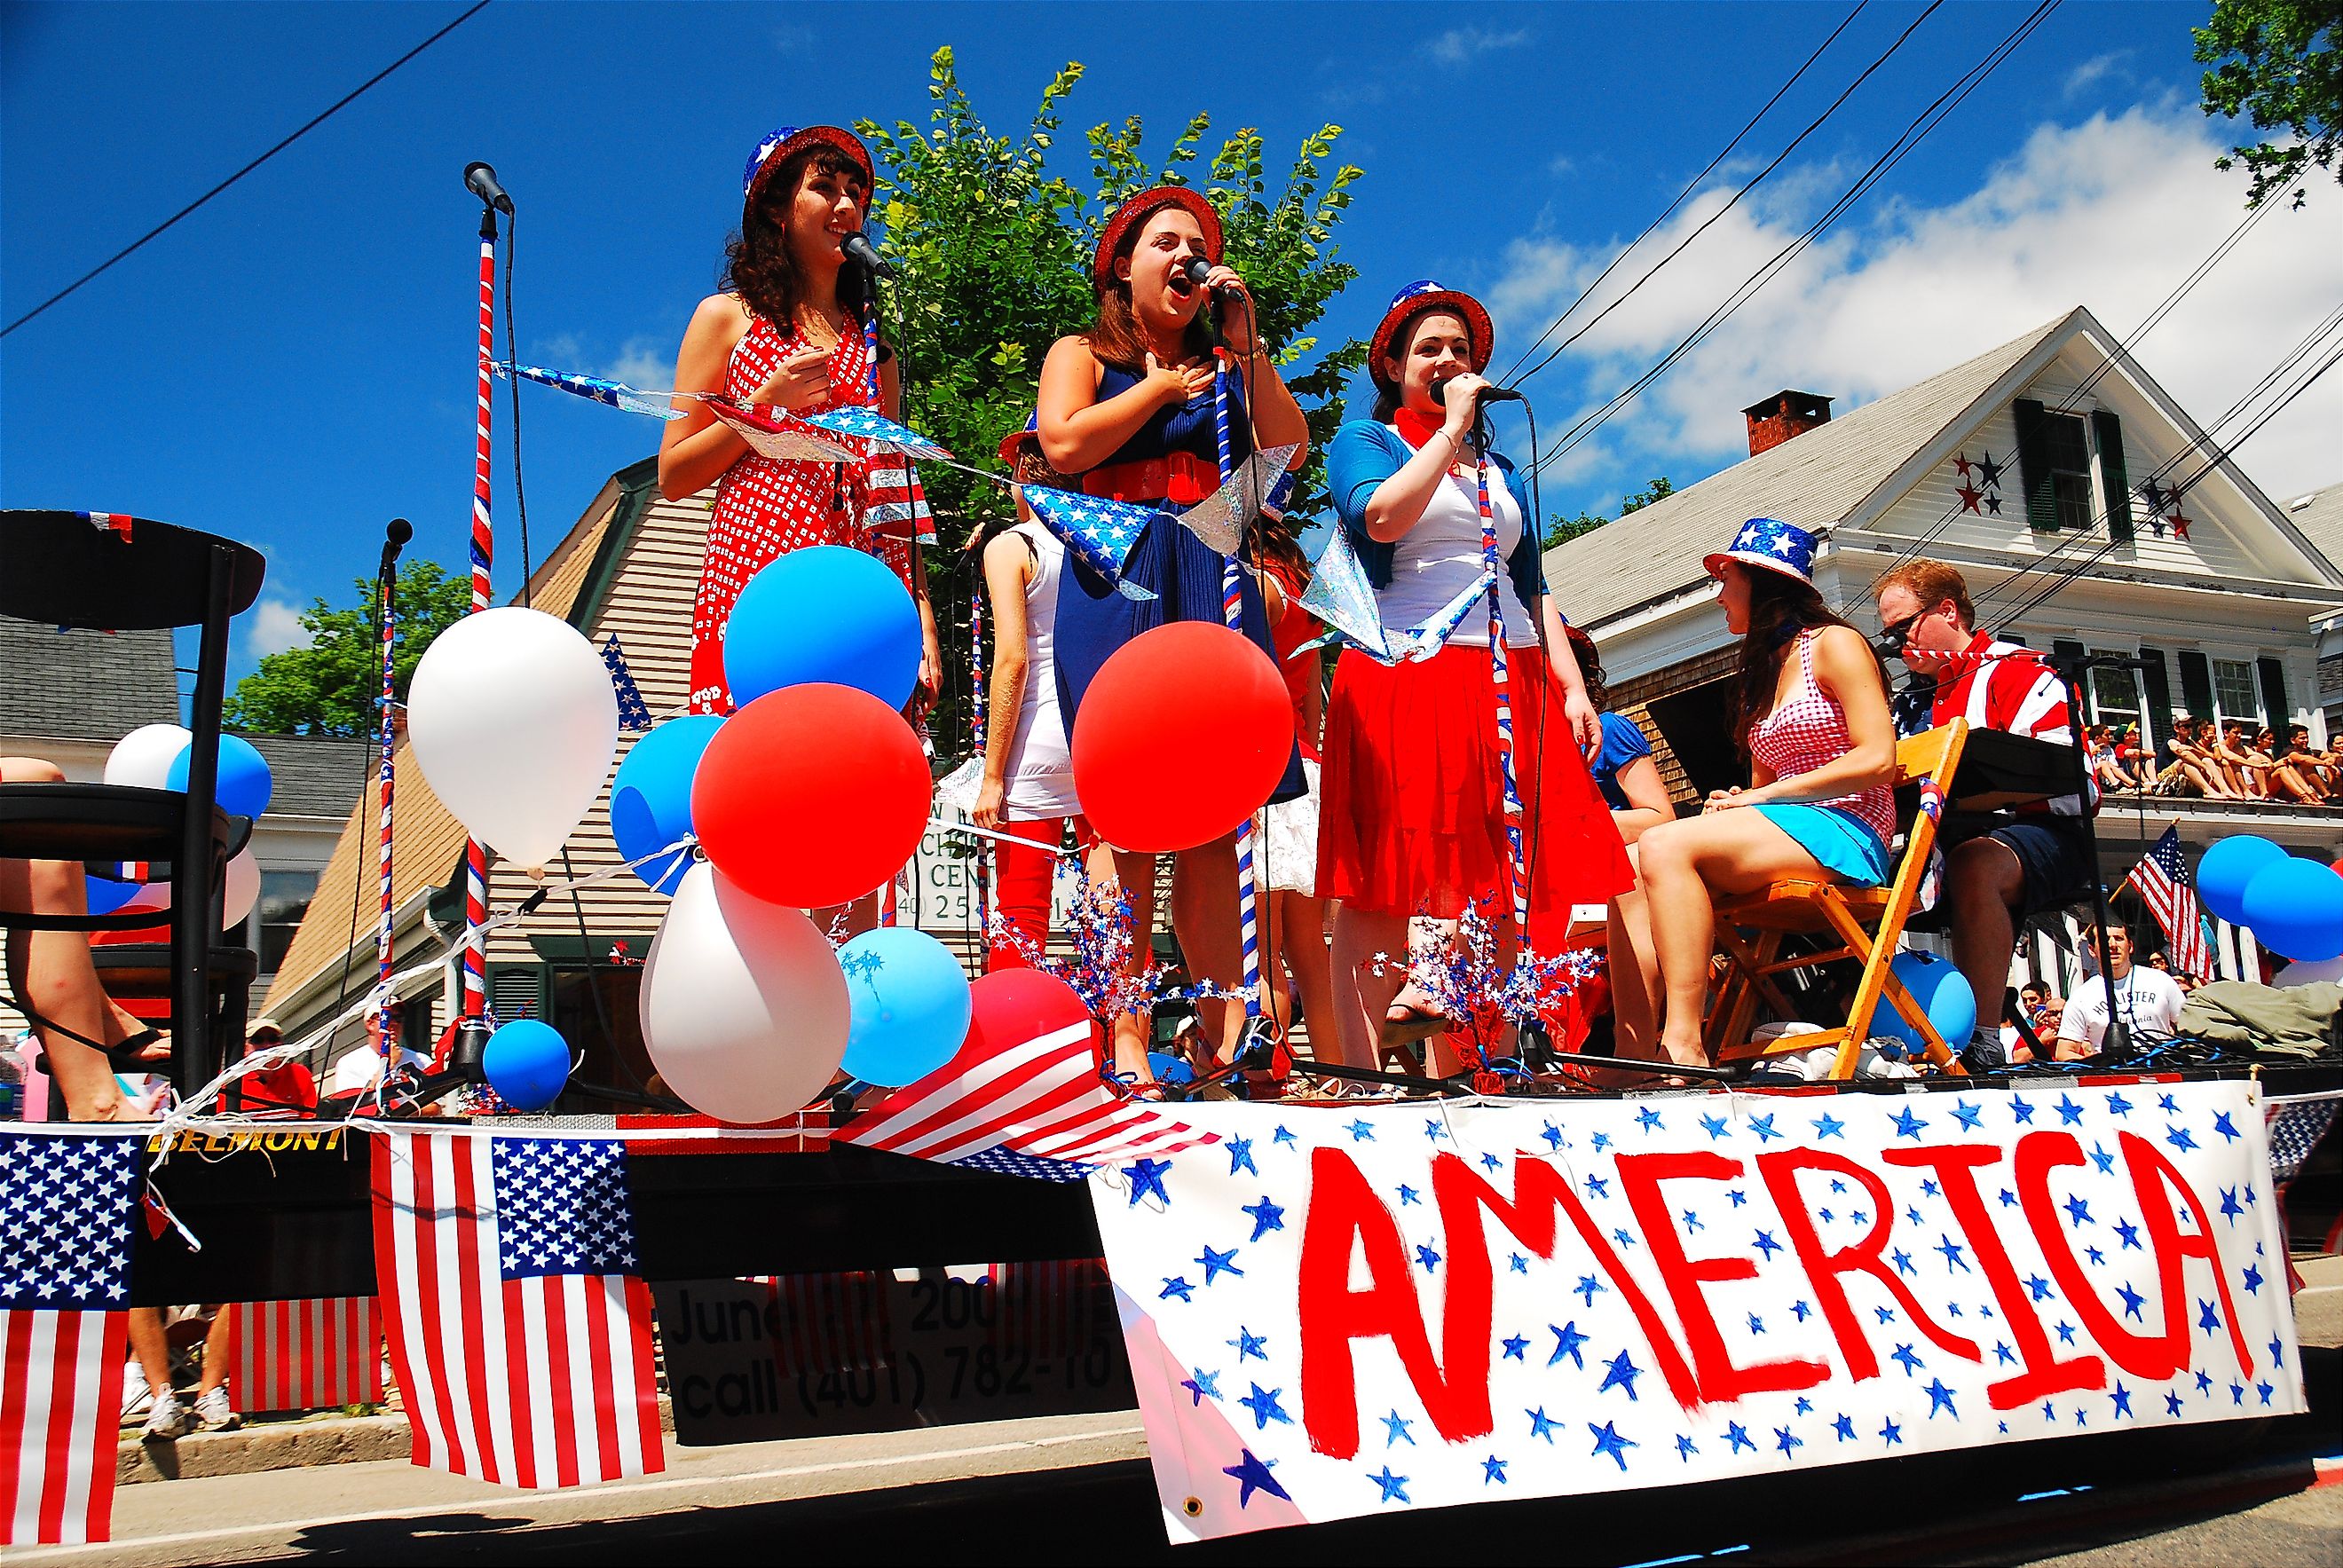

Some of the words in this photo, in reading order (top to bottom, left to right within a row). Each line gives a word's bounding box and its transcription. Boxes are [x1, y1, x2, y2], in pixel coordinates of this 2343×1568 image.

[2093, 991, 2157, 1016] HOLISTER
[911, 1274, 1027, 1331] 200
[1299, 1130, 2256, 1460] AMERICA
[682, 1358, 779, 1419] call
[799, 1350, 925, 1418] (401)
